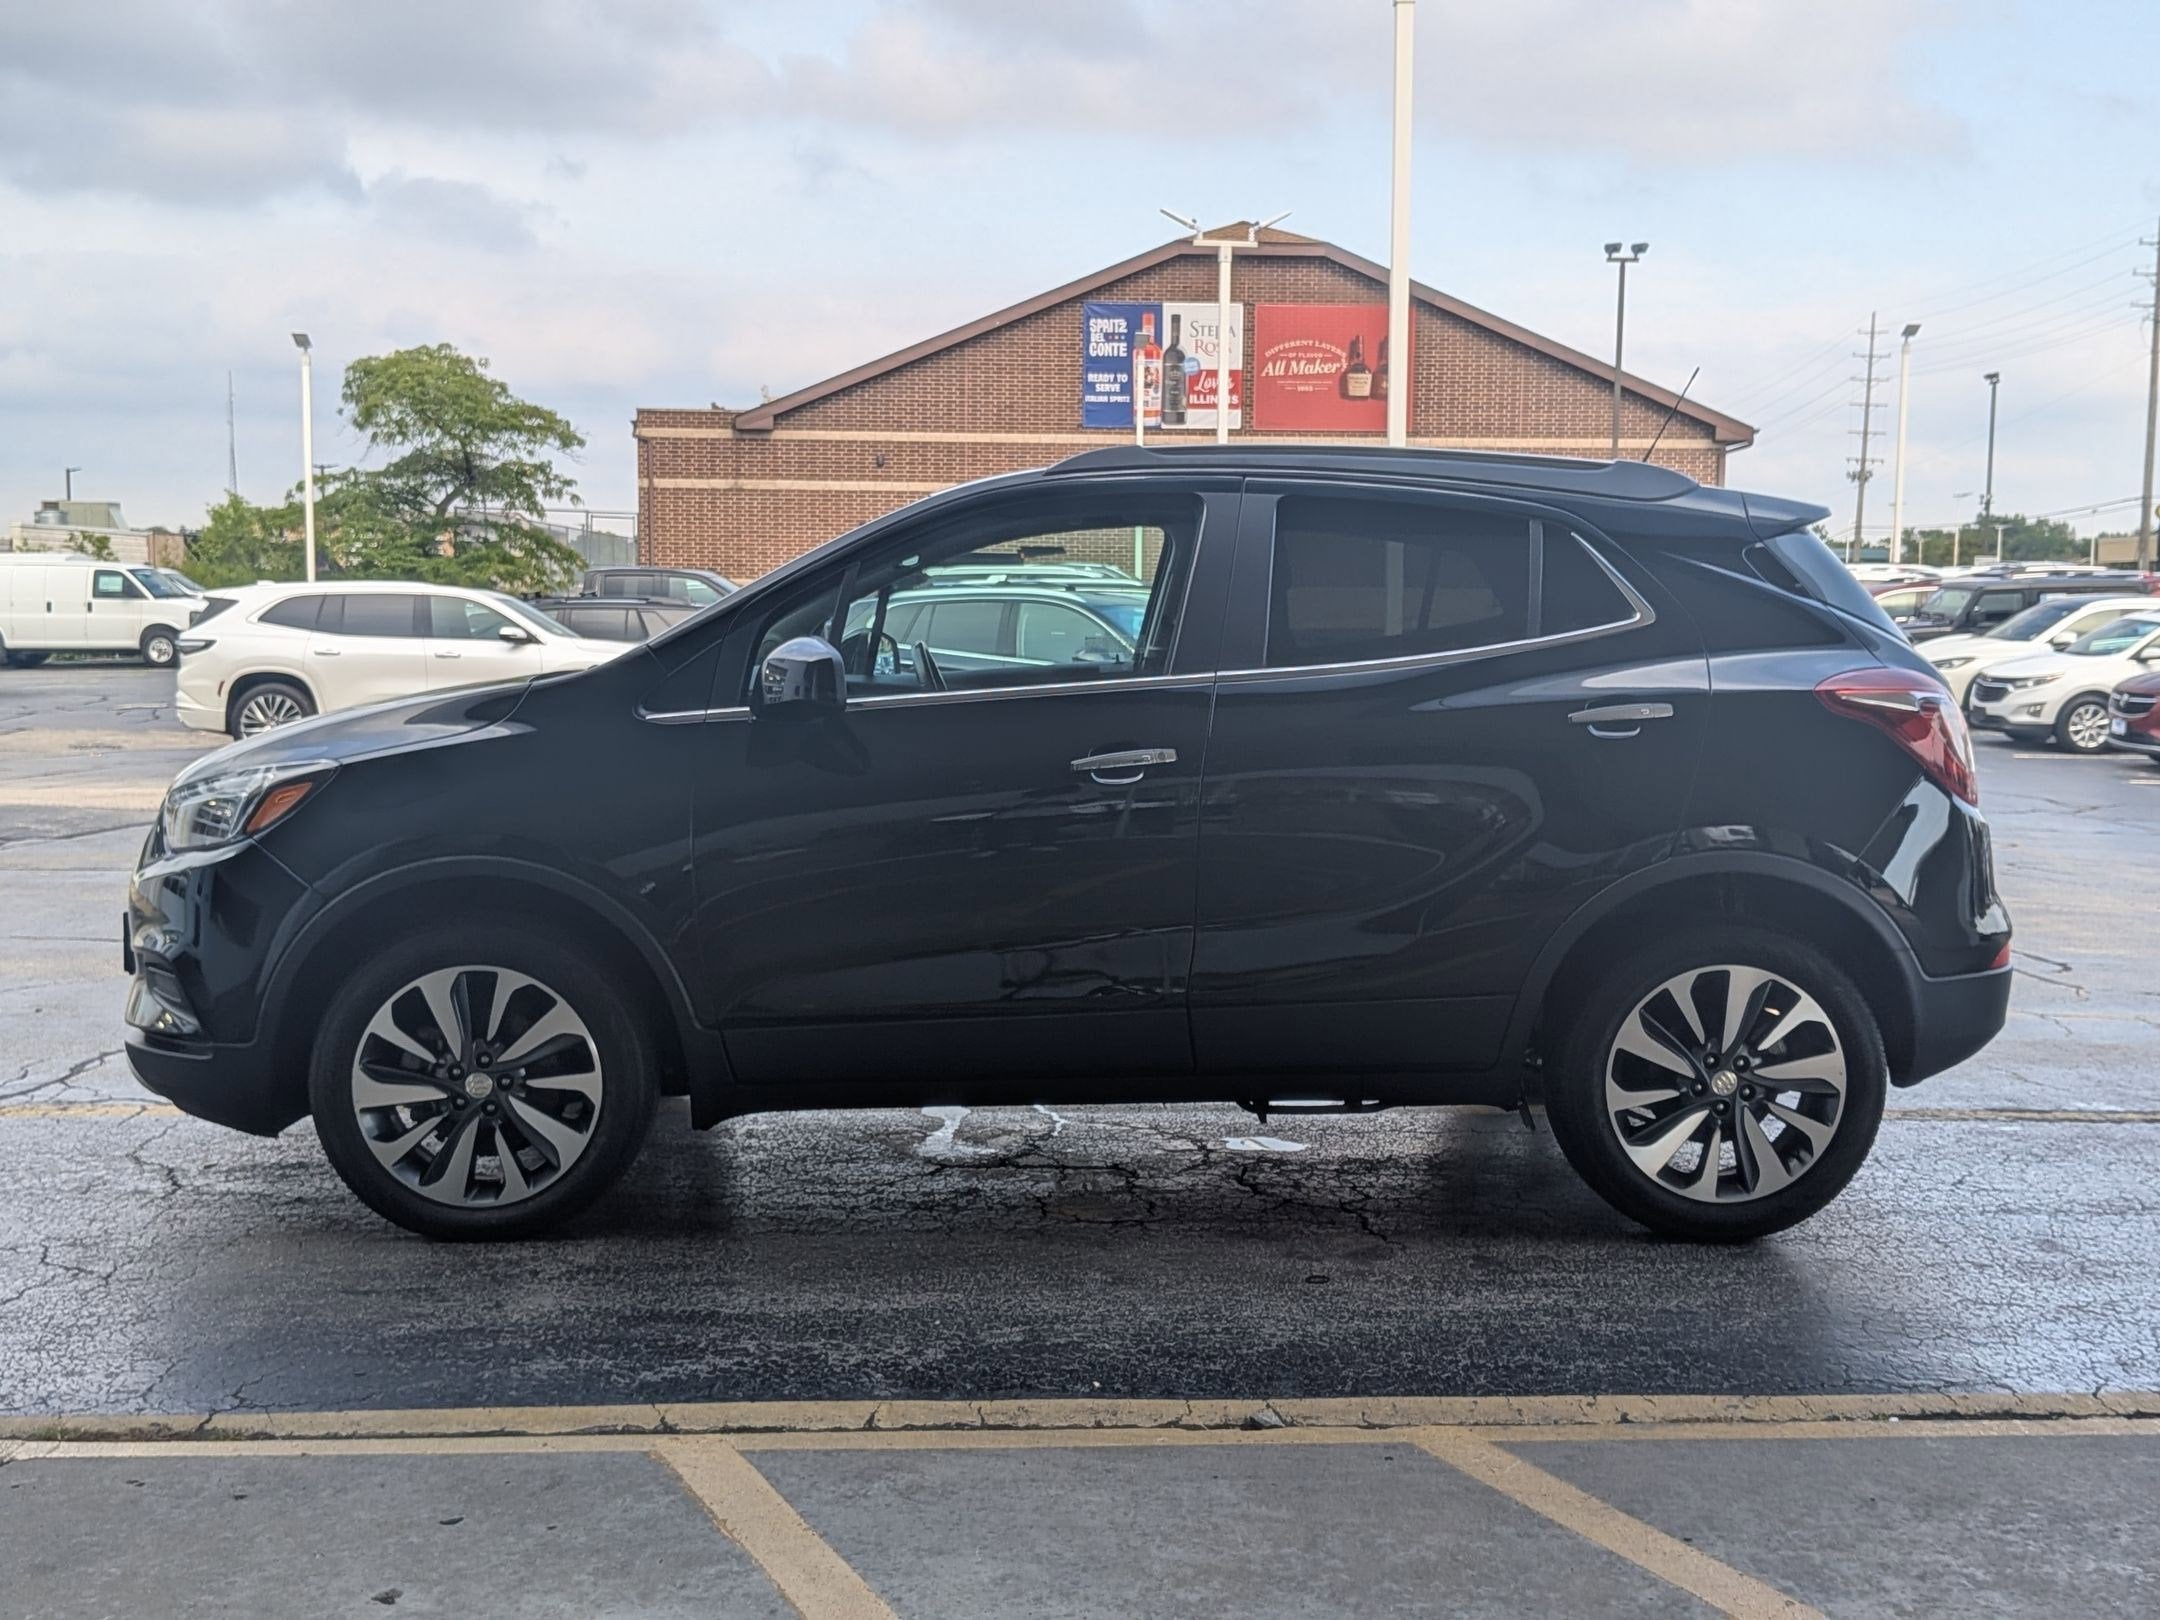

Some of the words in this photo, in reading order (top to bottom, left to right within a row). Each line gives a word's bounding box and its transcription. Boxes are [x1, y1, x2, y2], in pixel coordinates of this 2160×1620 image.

[1089, 318, 1128, 333] SPRITZ
[1189, 320, 1236, 339] STELA
[1089, 342, 1128, 357] CONTE
[1194, 339, 1232, 357] RO
[1264, 340, 1313, 357] DIFFERENT
[1260, 359, 1286, 377] All
[1087, 373, 1115, 383] READY
[1116, 373, 1129, 383] TO
[1193, 371, 1236, 393] Lovs
[1095, 383, 1121, 392] SERVE
[1189, 394, 1239, 404] ILLINS
